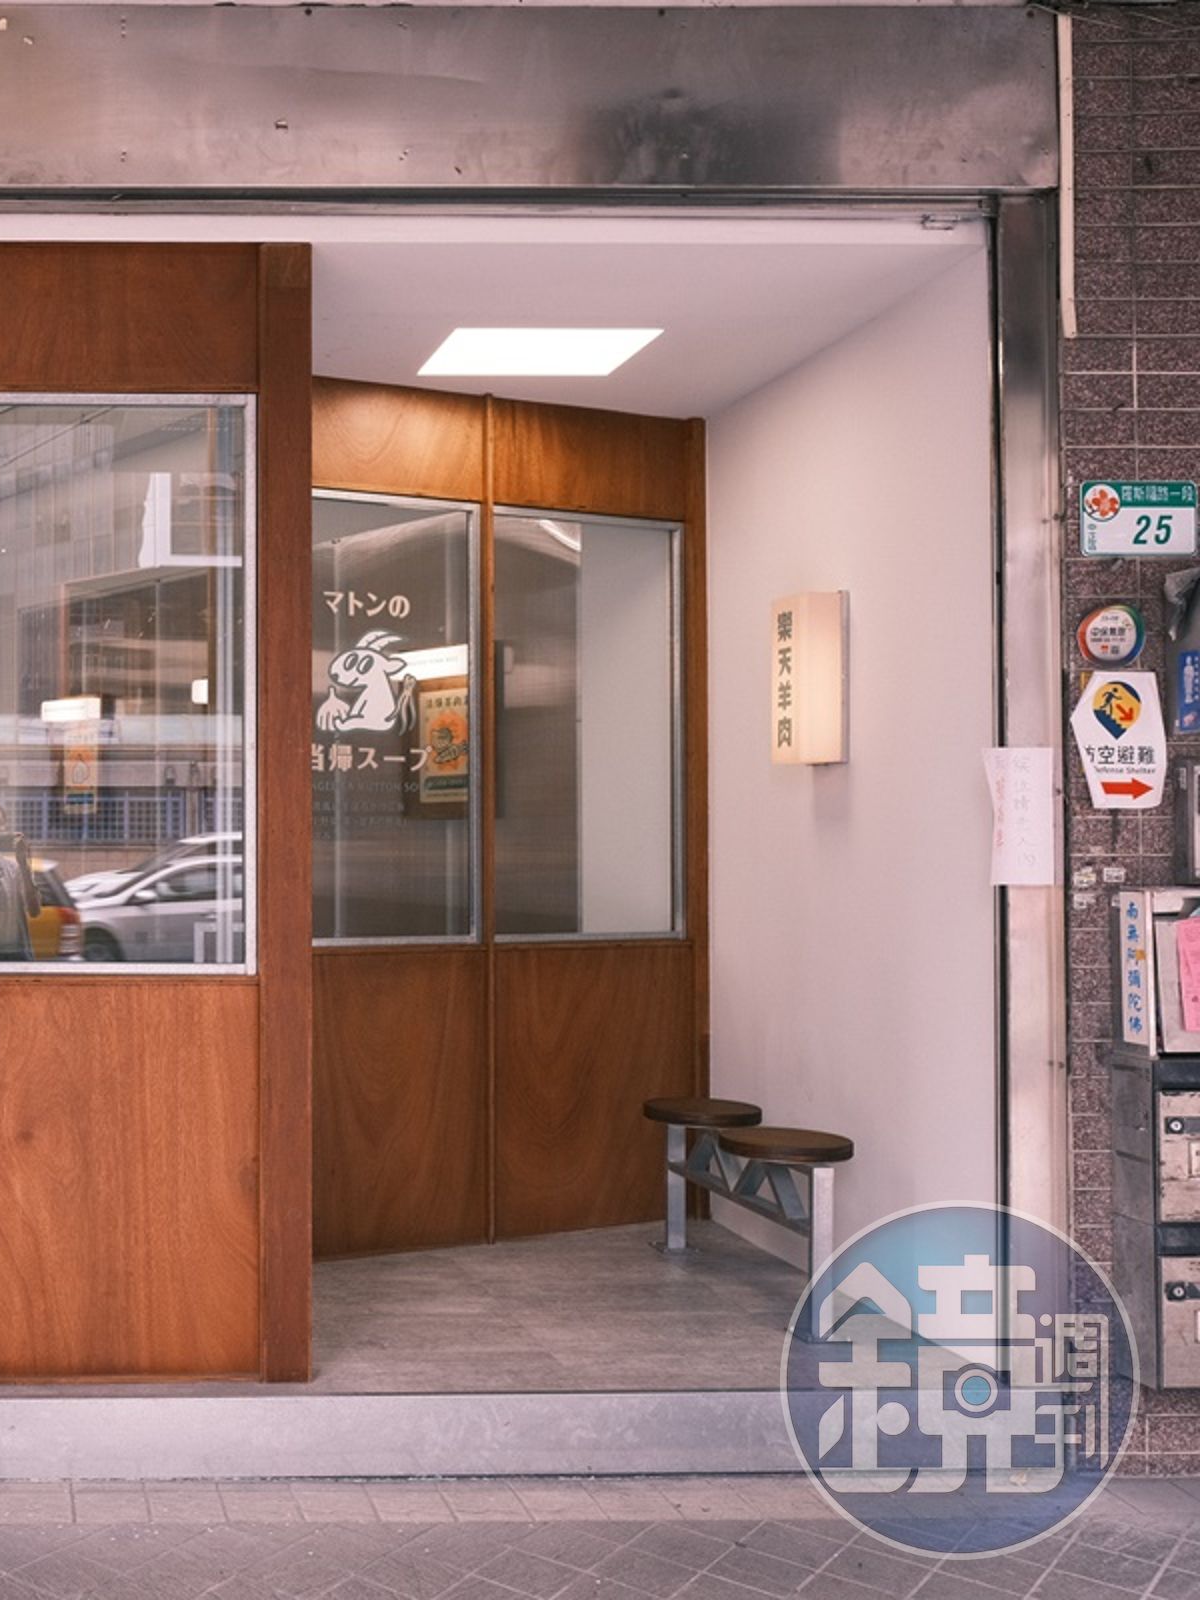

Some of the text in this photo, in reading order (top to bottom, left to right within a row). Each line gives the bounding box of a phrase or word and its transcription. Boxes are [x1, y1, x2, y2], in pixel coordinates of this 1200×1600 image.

[1132, 514, 1173, 545] 25
[323, 591, 411, 619] マトンの
[777, 611, 793, 749] 樂天羊肉
